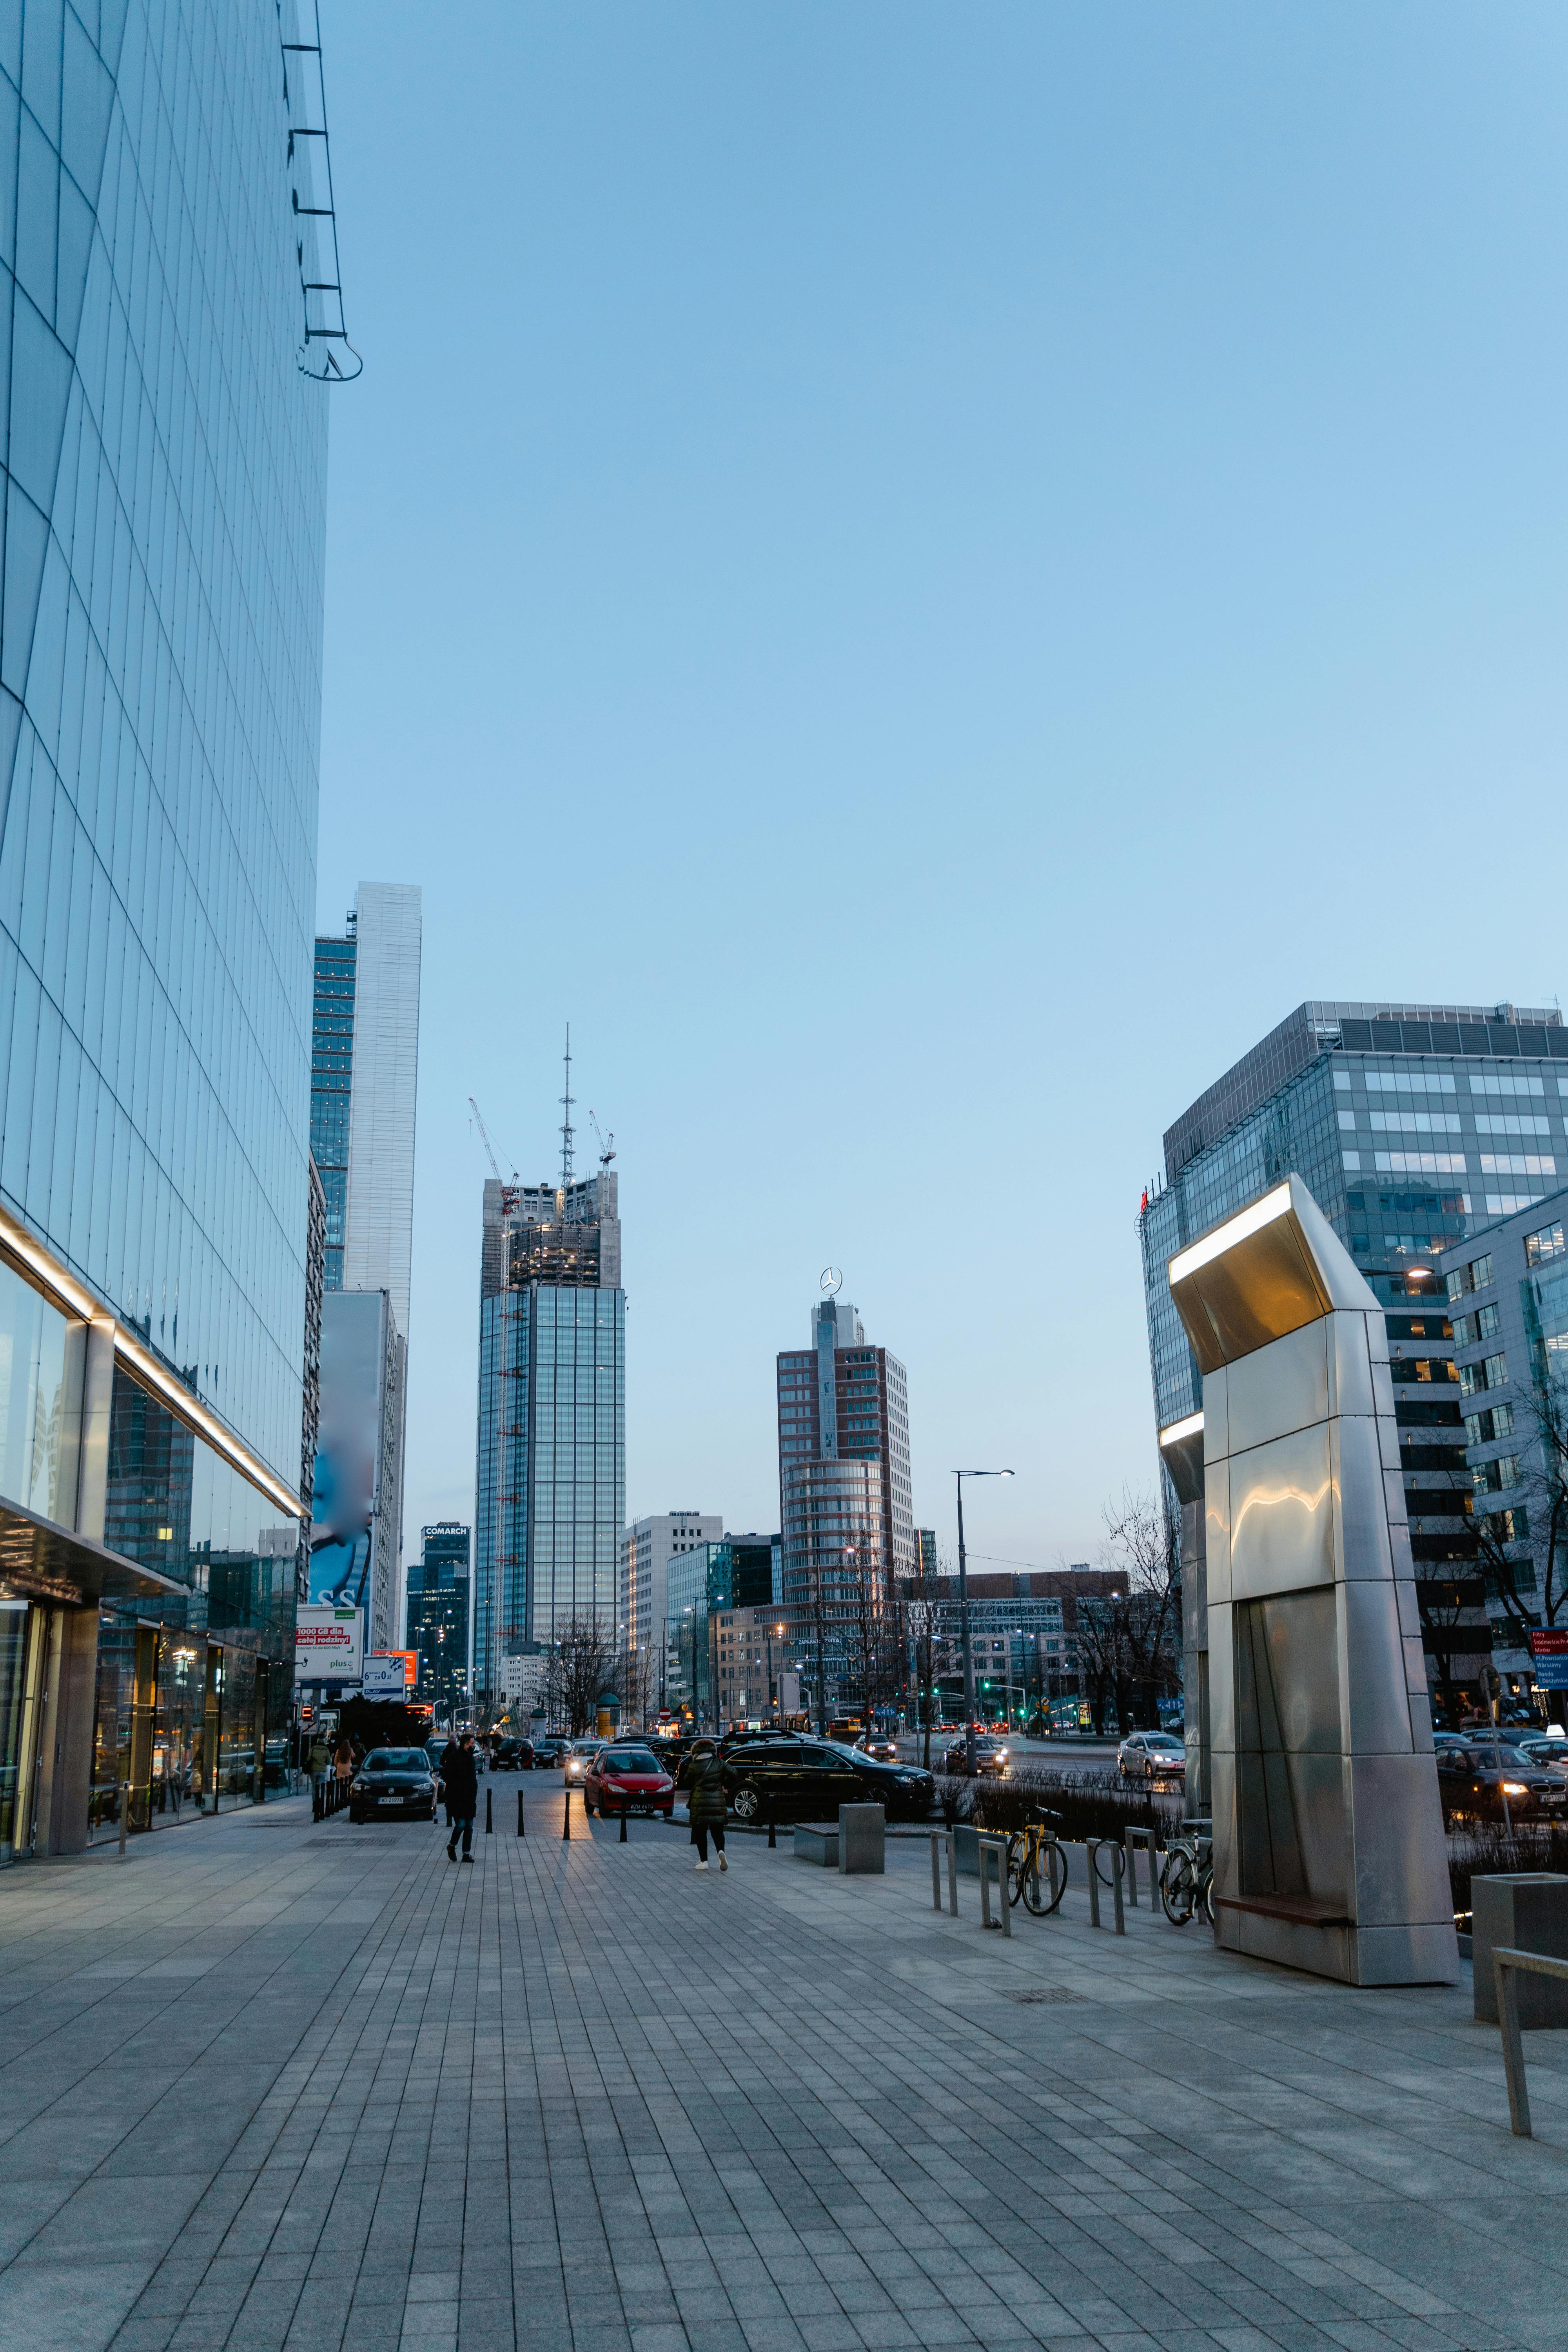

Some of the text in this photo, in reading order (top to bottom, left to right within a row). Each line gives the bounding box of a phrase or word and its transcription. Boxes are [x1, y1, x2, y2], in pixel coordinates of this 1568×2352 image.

[297, 1636, 316, 1644] całej
[330, 1660, 347, 1668] plus
[365, 1672, 369, 1680] 6
[381, 1671, 386, 1679] 0
